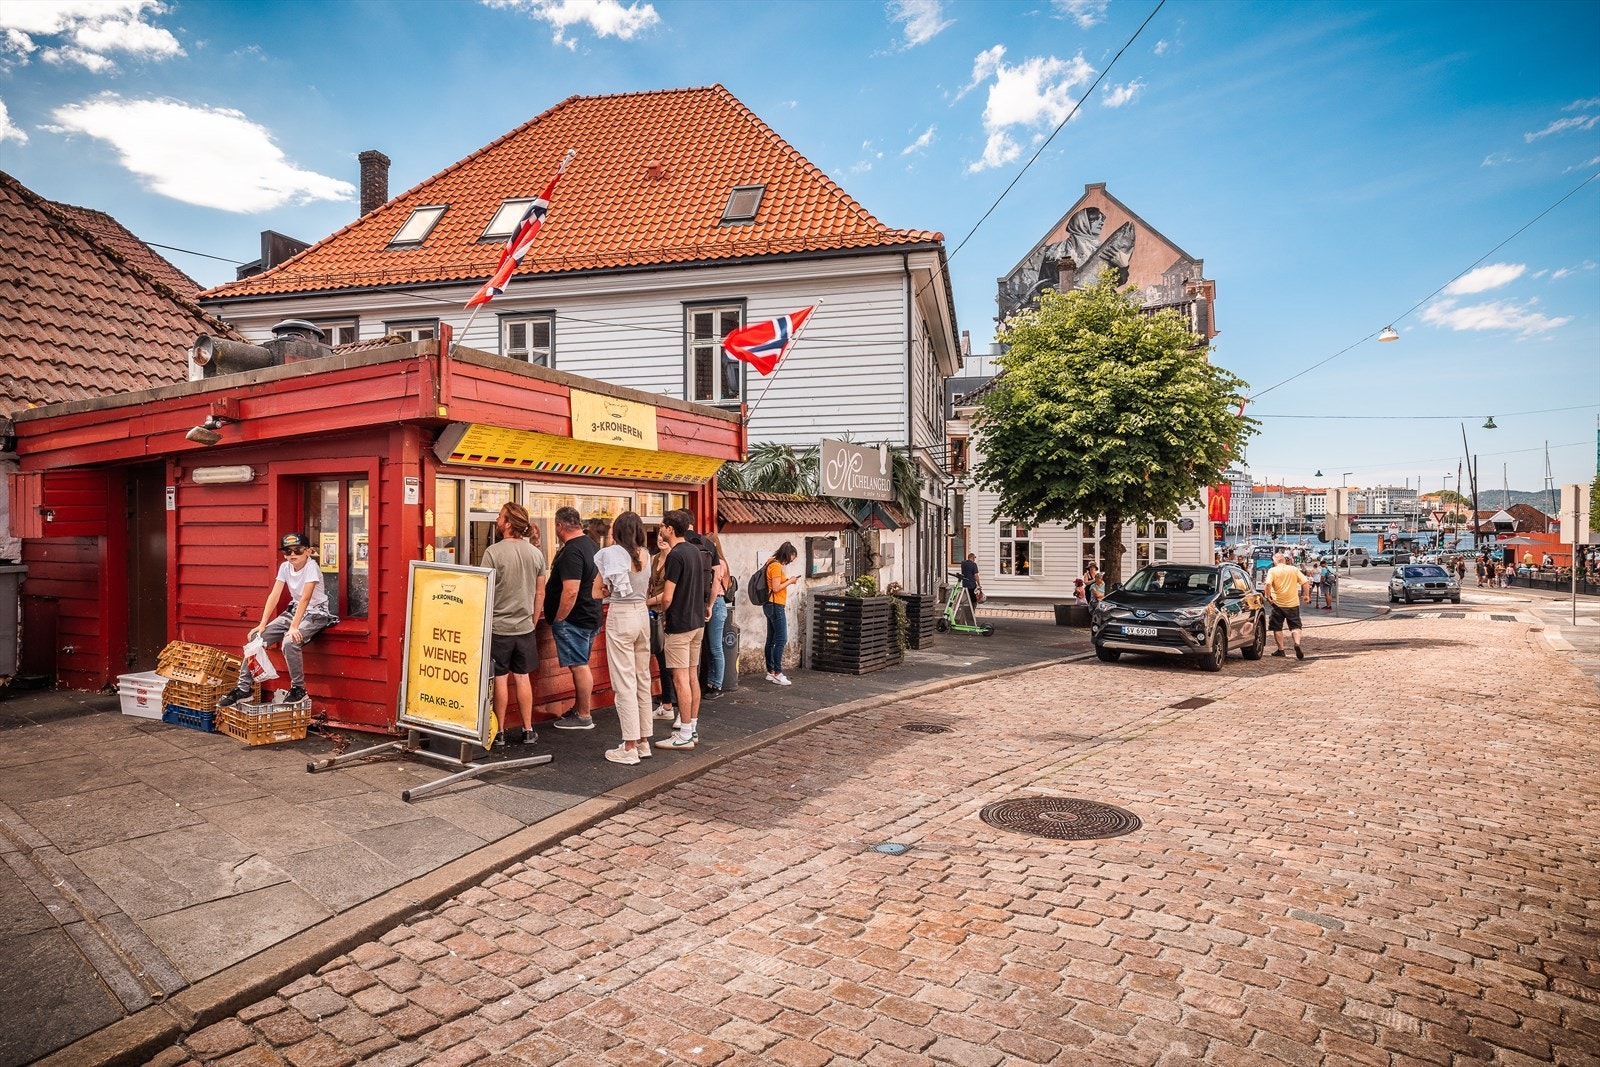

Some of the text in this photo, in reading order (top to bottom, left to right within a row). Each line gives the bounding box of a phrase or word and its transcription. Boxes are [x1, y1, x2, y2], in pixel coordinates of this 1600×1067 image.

[591, 421, 643, 440] 3-KRONEREN
[432, 594, 464, 604] 3-KRONEREN
[433, 628, 461, 644] EKTE
[423, 645, 467, 664] WIENER
[419, 664, 469, 685] HOT DOG
[420, 693, 465, 710] FRA KR: 20.-
